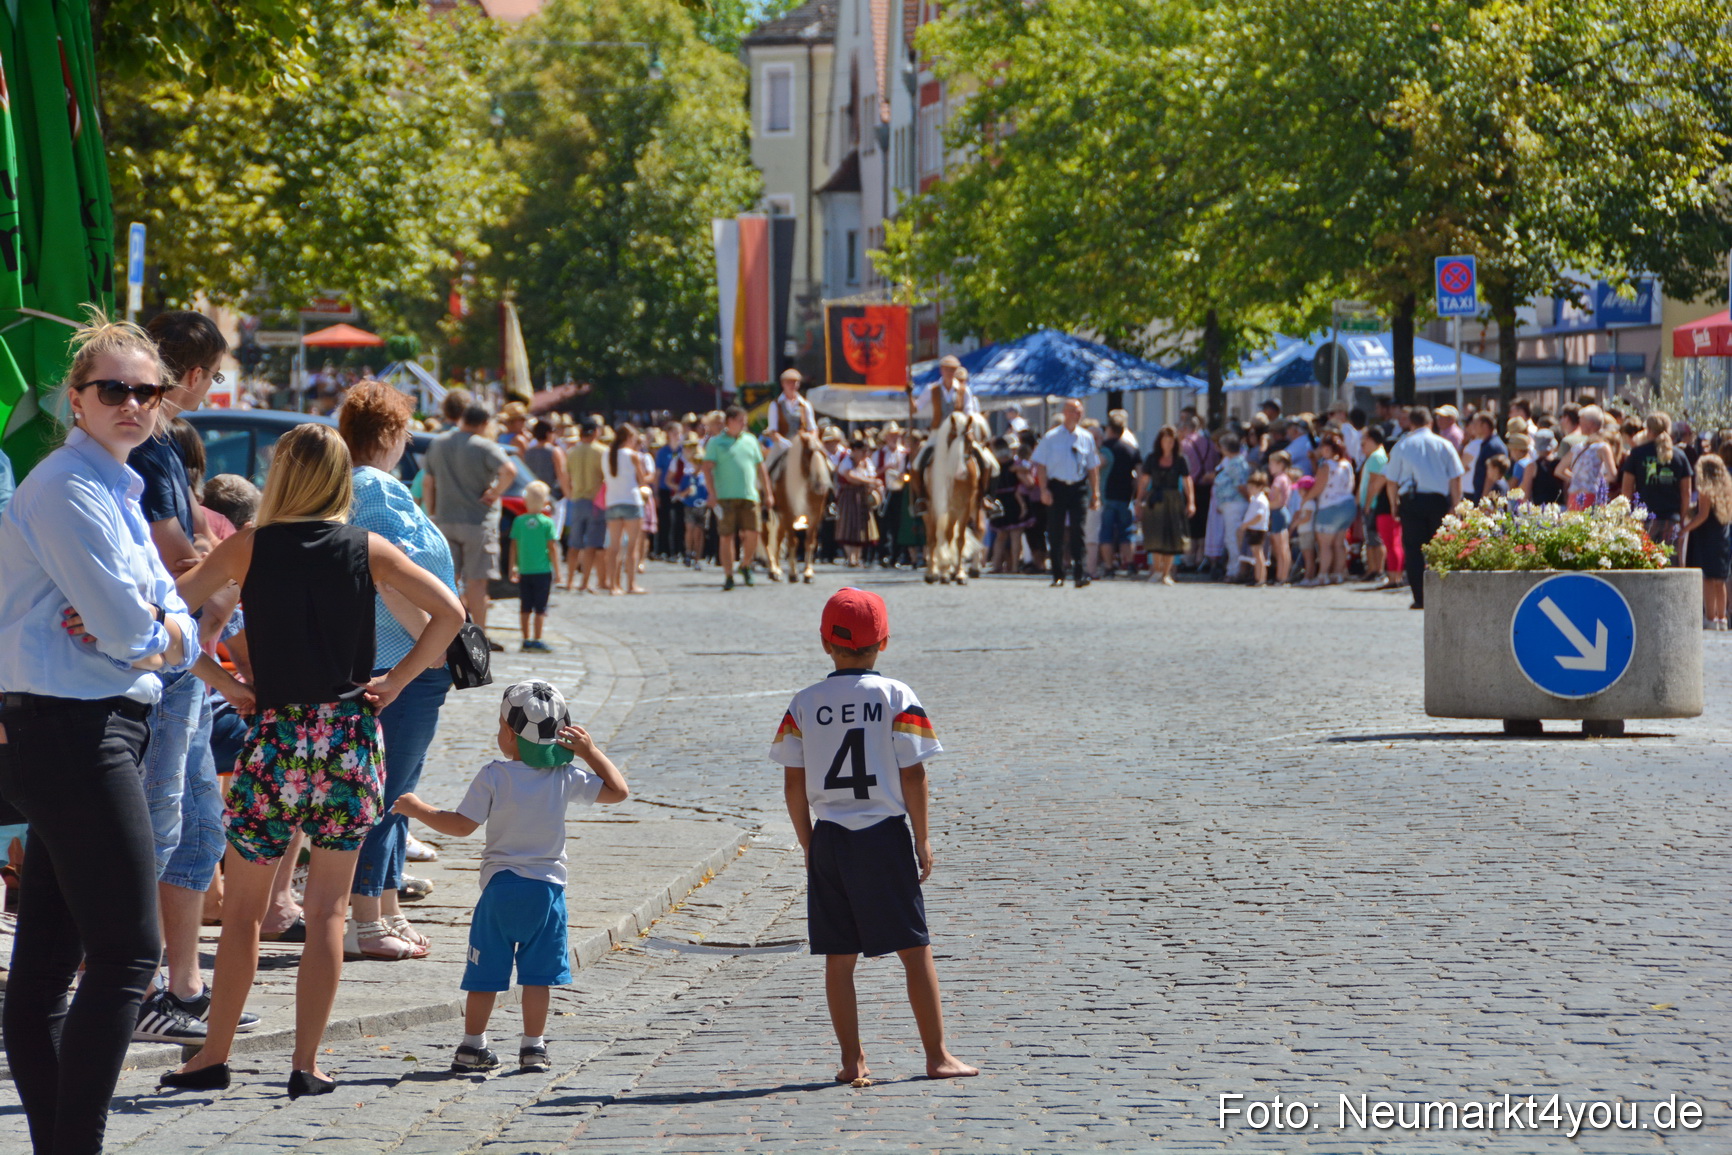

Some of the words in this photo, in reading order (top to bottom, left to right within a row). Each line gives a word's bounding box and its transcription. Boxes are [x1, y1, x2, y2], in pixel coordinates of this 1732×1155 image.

[1440, 296, 1473, 310] TAXI
[816, 702, 882, 725] CEM
[824, 728, 877, 800] 4
